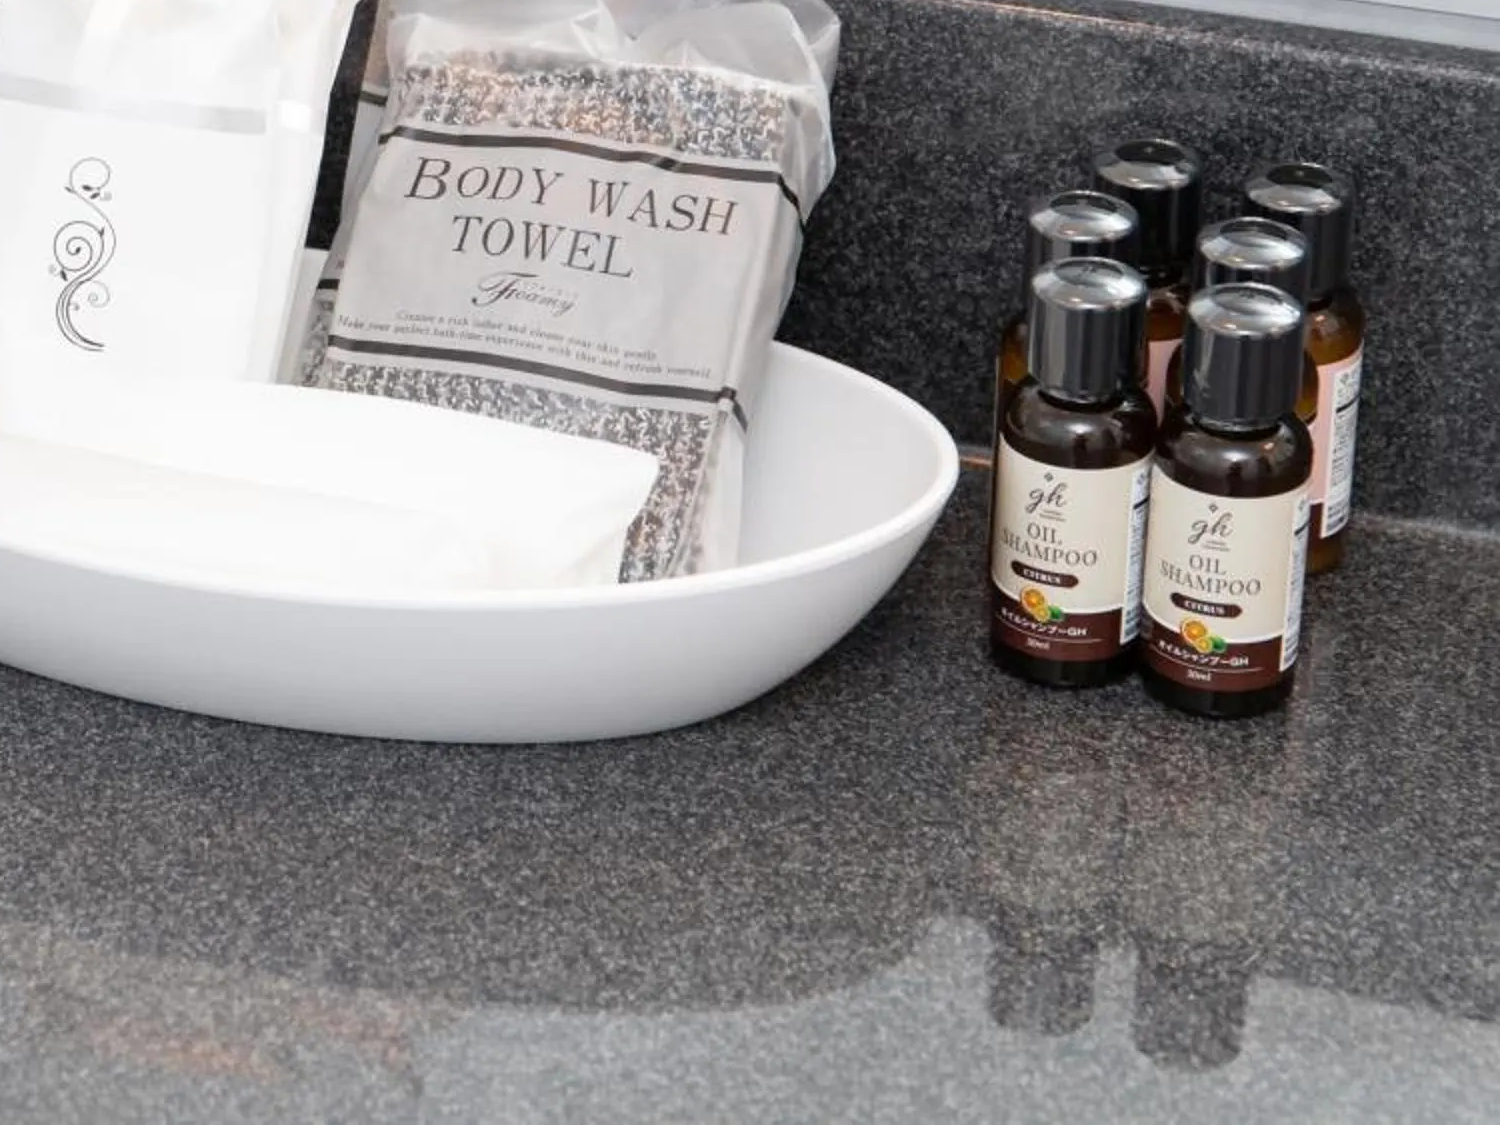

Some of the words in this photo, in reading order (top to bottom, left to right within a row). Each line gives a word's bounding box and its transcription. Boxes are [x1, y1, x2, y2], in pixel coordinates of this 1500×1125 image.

[403, 156, 565, 207] BODY
[586, 177, 739, 236] WASH
[450, 214, 635, 279] TOWEL
[1001, 528, 1098, 567] SHAMPOO
[1026, 522, 1063, 545] OIL
[1159, 559, 1262, 596] SHAMPOO
[1189, 554, 1227, 576] OIL
